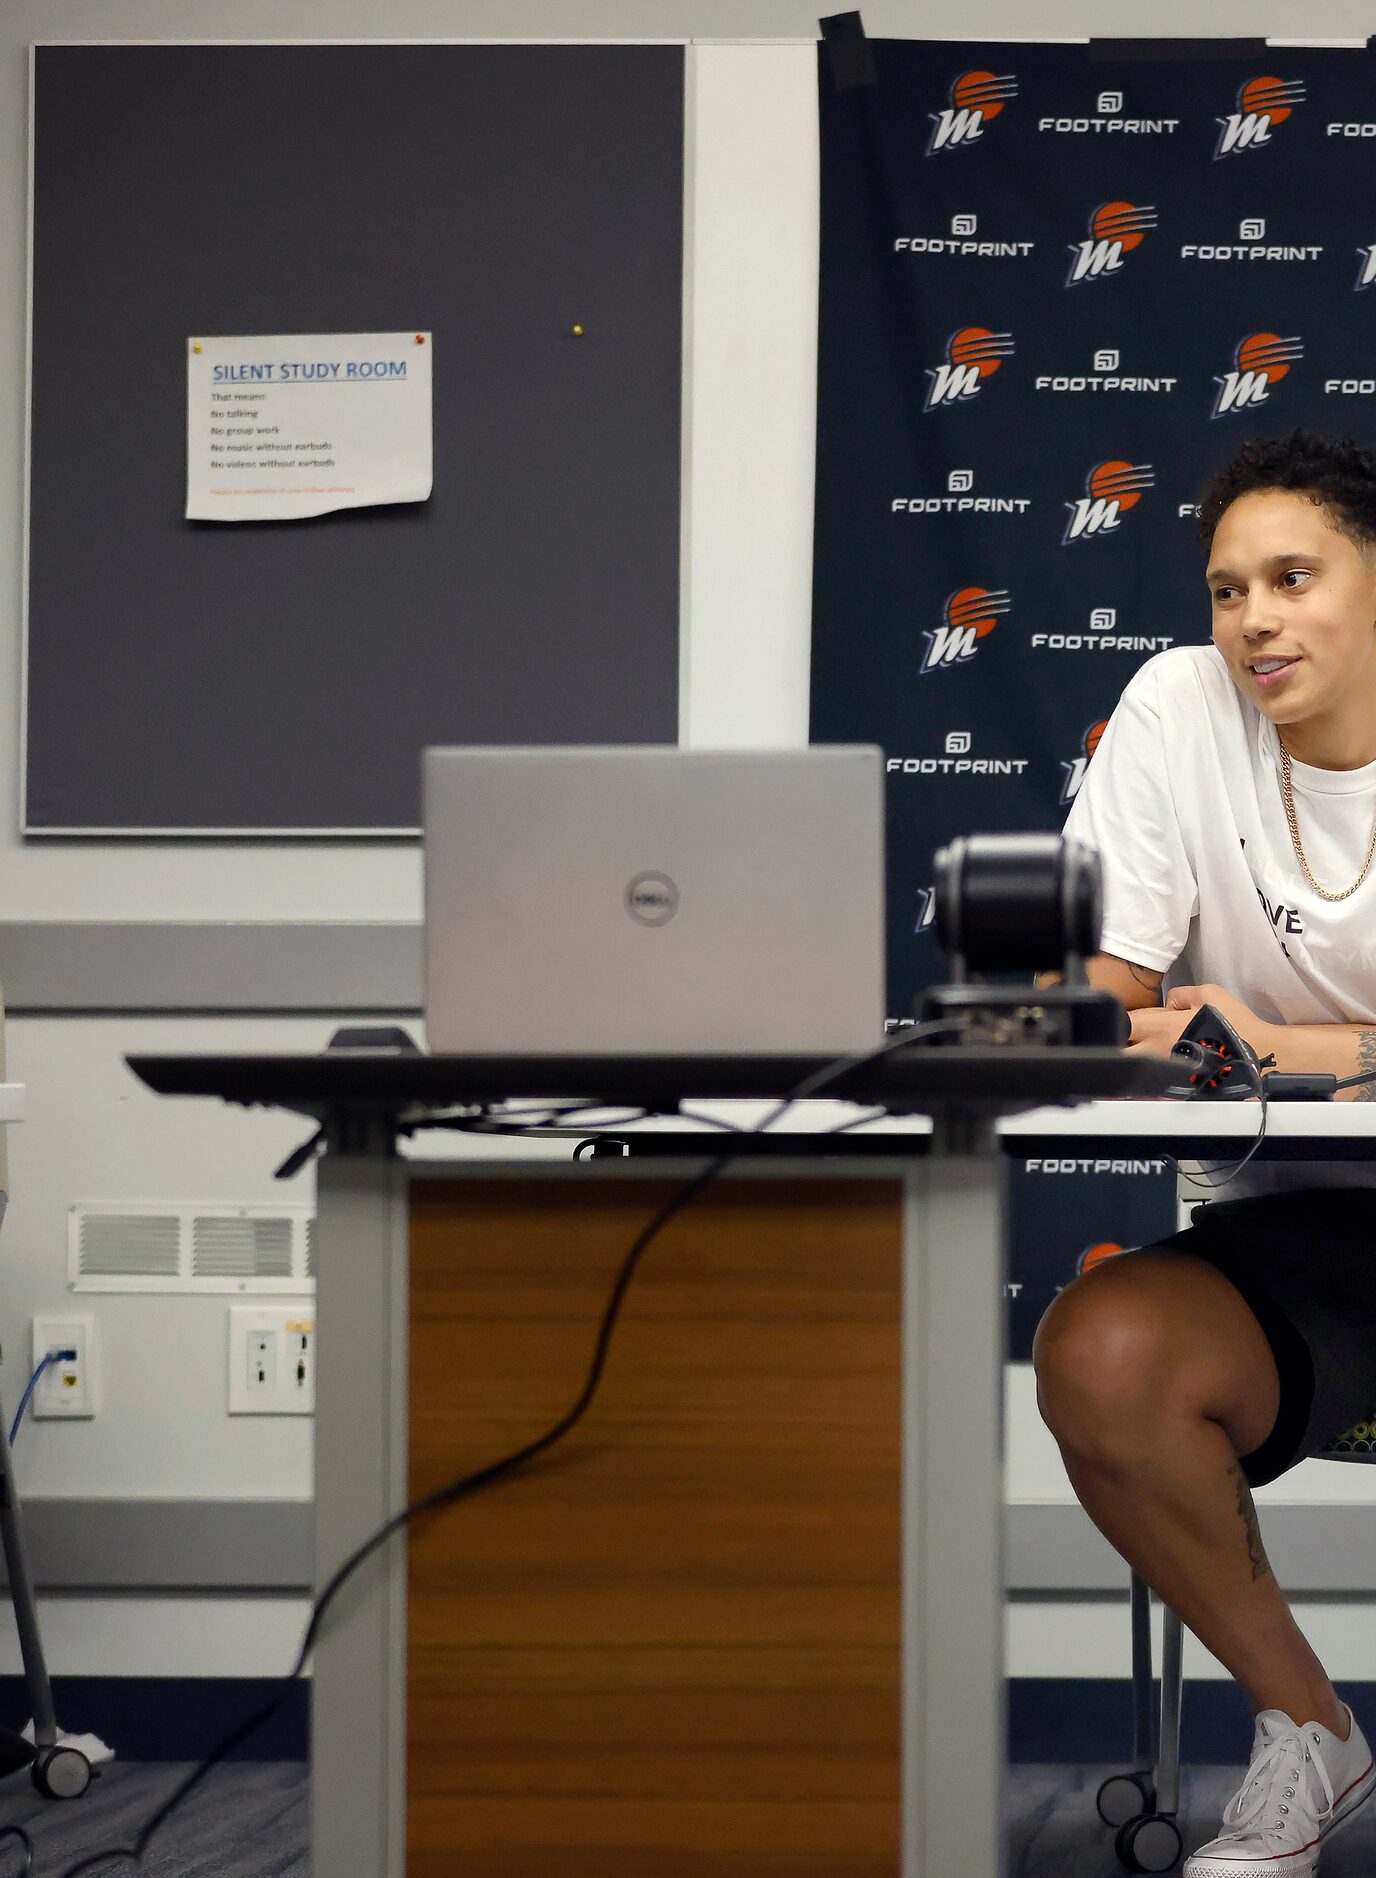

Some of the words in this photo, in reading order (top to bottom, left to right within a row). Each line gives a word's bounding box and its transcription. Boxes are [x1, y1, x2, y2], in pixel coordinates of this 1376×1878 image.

[1039, 118, 1180, 134] FOOTPRINT
[895, 238, 1034, 257] FOOTPRINT
[1181, 245, 1323, 261] FOOTPRINT
[213, 364, 274, 381] SILENT
[281, 362, 340, 380] STUDY
[347, 361, 407, 378] ROOM
[1035, 376, 1177, 392] FOOTPRINT
[210, 410, 225, 419] No
[226, 409, 259, 420] talking
[210, 427, 225, 436] No
[226, 428, 254, 438] group
[256, 425, 280, 435] work
[210, 444, 224, 453] No
[256, 442, 292, 452] without
[294, 441, 333, 451] earbuds
[210, 460, 225, 469] No
[259, 459, 296, 469] without
[298, 457, 336, 468] earbuds
[891, 498, 1031, 514] FOOTPRINT
[1031, 633, 1174, 653] FOOTPRINT
[886, 758, 1029, 775] FOOTPRINT
[1025, 1159, 1166, 1175] FOOTPRINT
